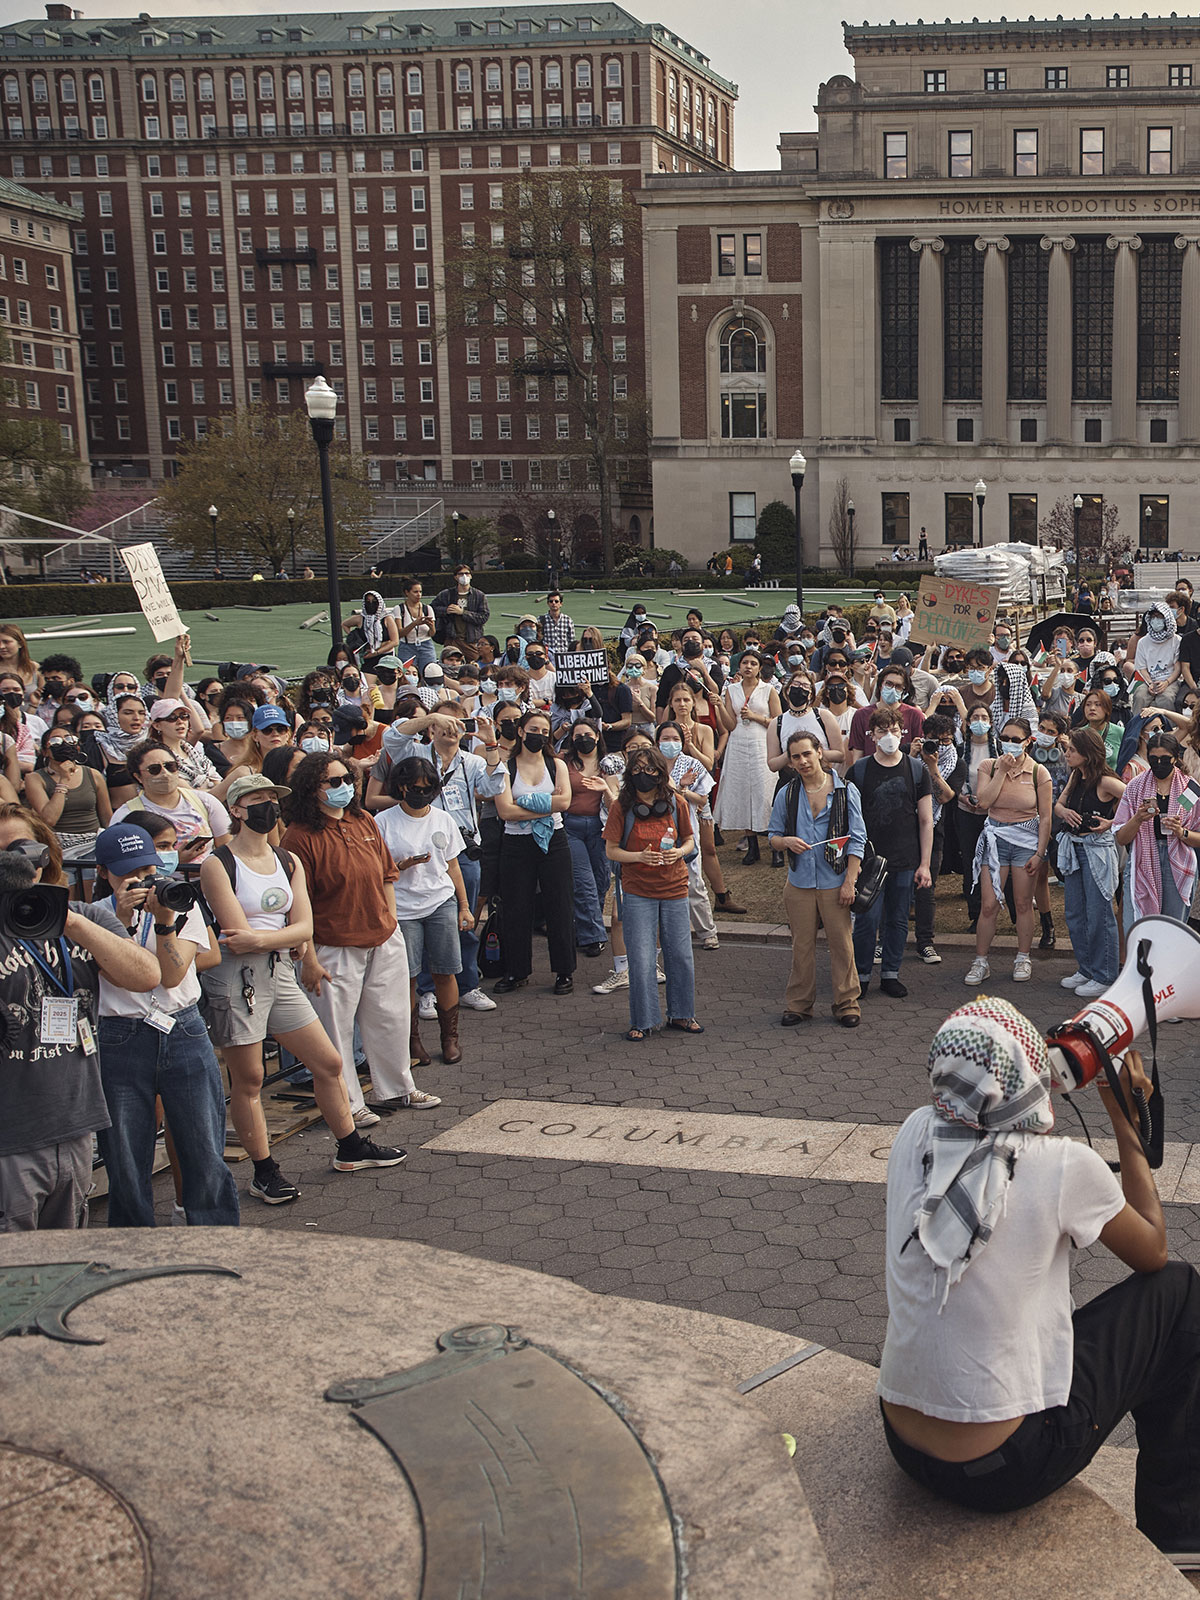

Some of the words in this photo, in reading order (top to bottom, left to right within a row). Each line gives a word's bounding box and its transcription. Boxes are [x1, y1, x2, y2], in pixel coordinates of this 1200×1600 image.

[939, 201, 1005, 215] HOMER
[1019, 199, 1137, 214] HERODOTUS
[945, 584, 991, 606] DYKES
[953, 603, 971, 616] FOR
[557, 652, 605, 669] LIBERATE
[556, 667, 608, 685] PALESTINE
[29, 1043, 62, 1062] Fist
[498, 1118, 813, 1156] COLUMBIA
